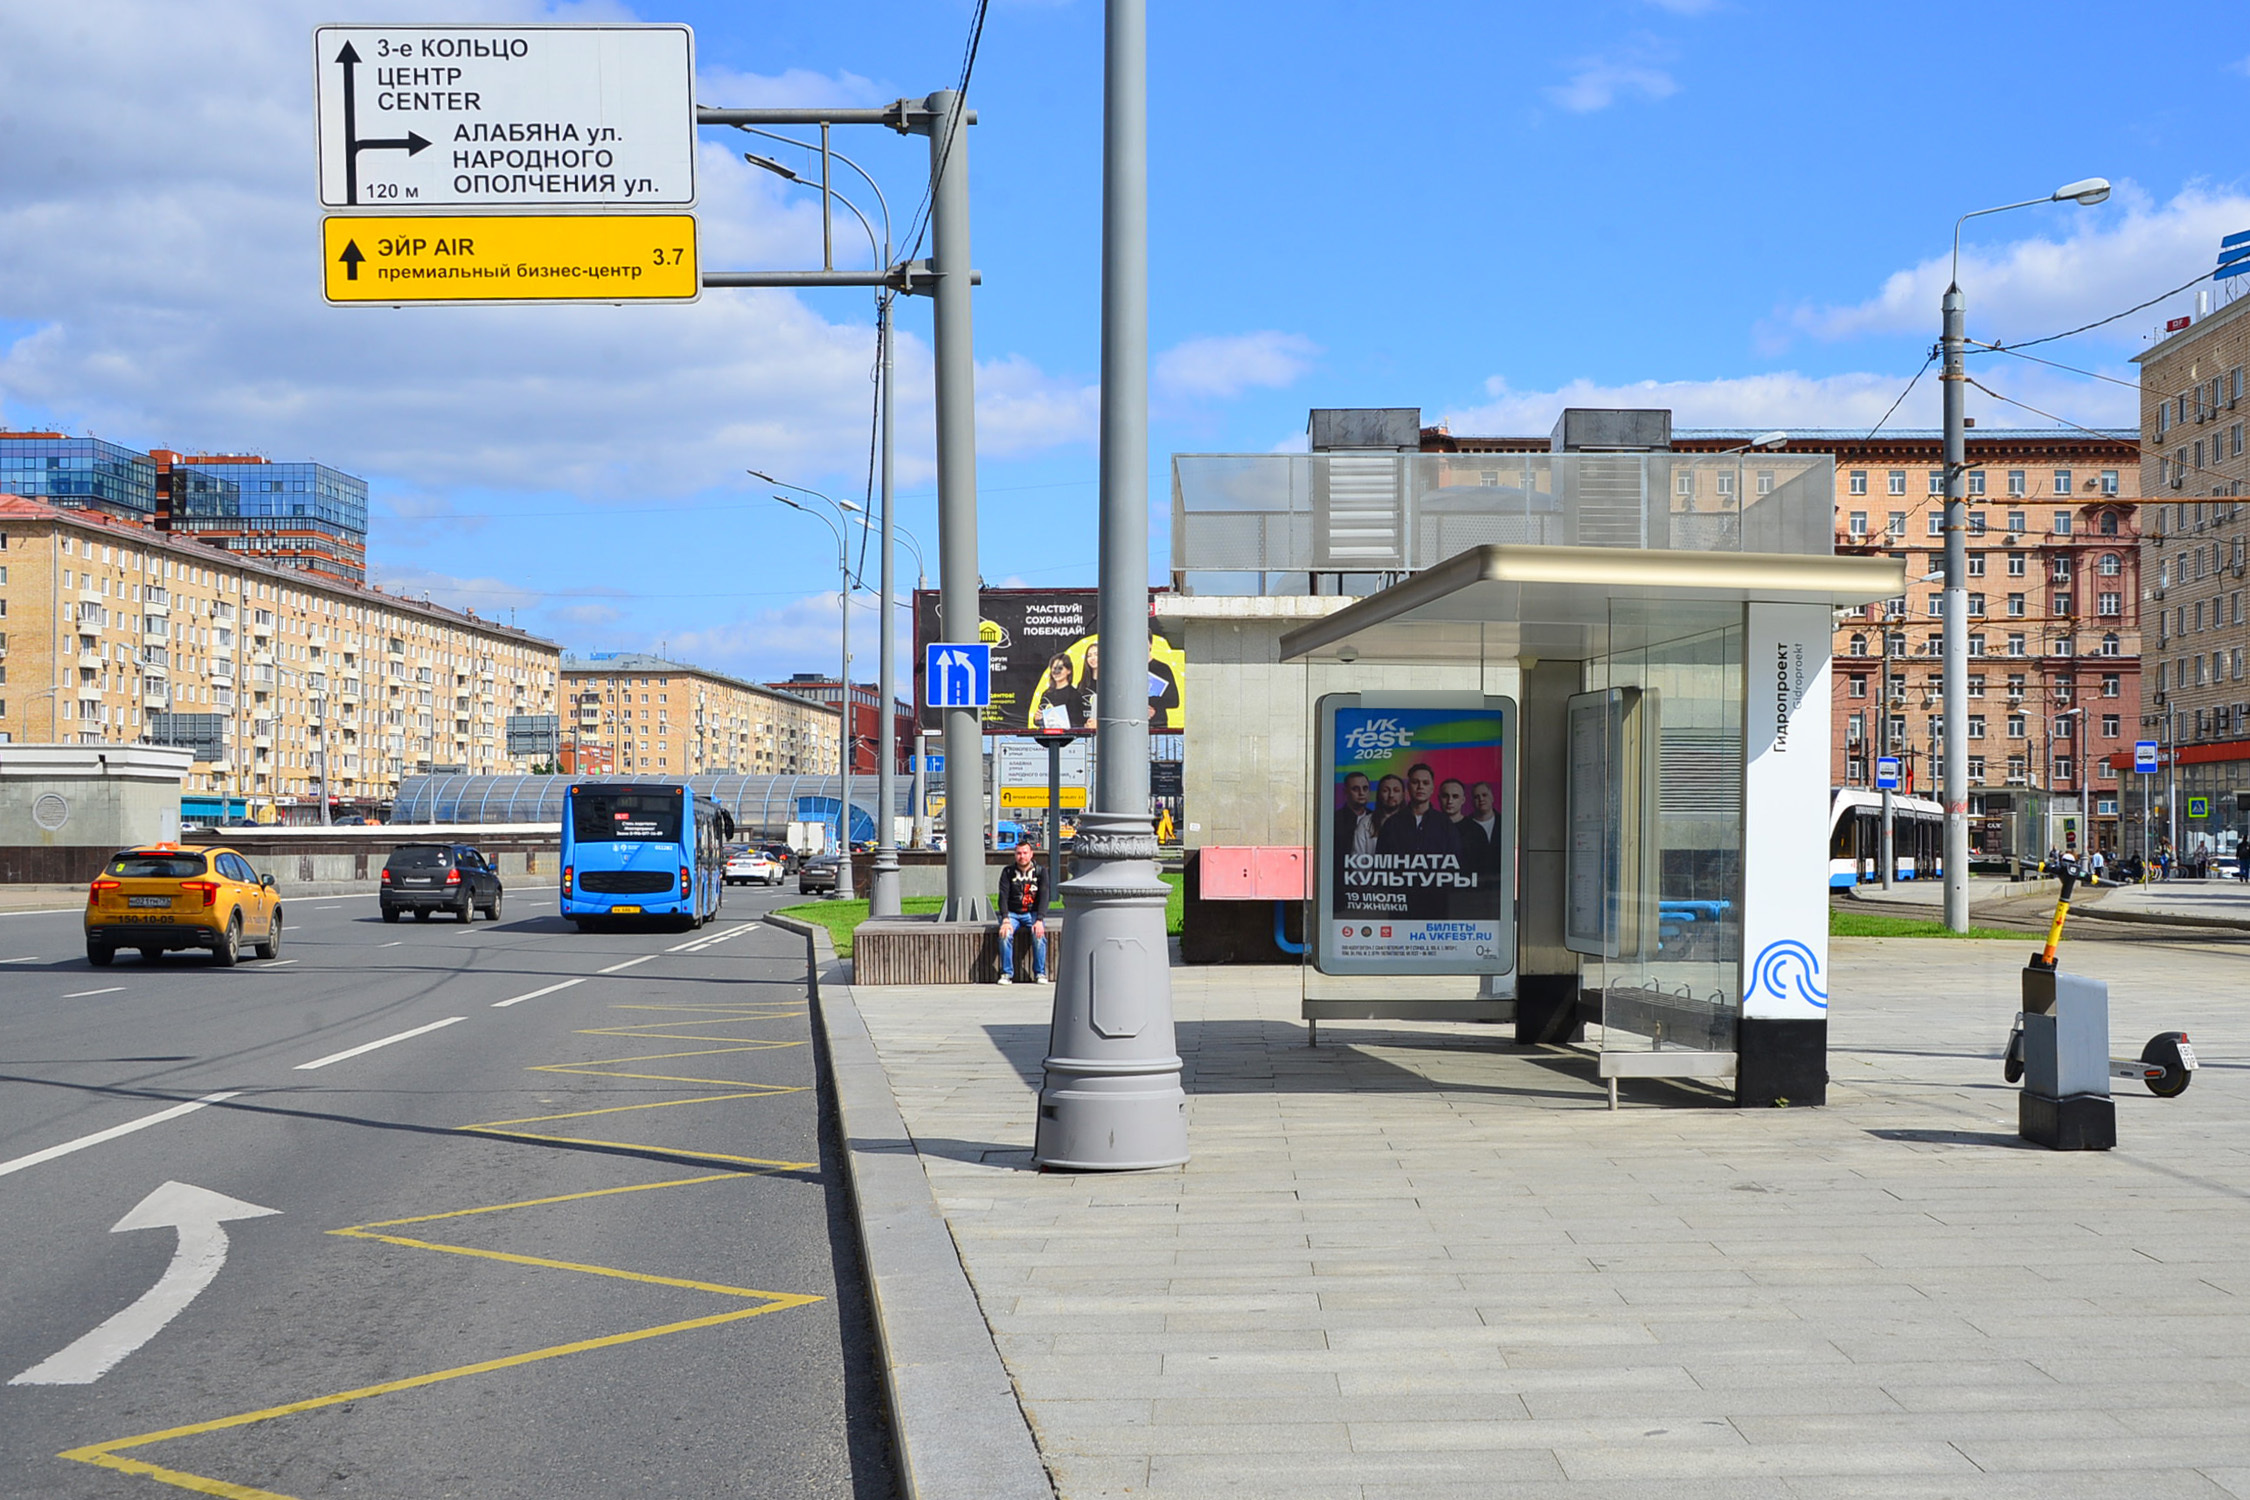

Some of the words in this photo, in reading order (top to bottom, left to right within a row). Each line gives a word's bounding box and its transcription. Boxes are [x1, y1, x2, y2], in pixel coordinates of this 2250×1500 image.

[377, 39, 413, 57] 3-е
[421, 38, 529, 61] КОЛЬЦО
[377, 67, 462, 89] ЦЕНТР
[377, 92, 482, 111] CENTER
[453, 123, 580, 142] АЛАБЯНА
[586, 127, 623, 146] ул.
[453, 149, 614, 172] НАРОДНОГО
[366, 184, 399, 199] 120
[405, 187, 419, 198] м
[453, 174, 616, 194] ОПОЛЧЕНИЯ
[623, 178, 660, 197] ул.
[377, 235, 427, 256] ЭЙР
[434, 238, 475, 256] AIR
[652, 248, 684, 266] 3.7
[377, 264, 511, 282] премиальный
[516, 262, 643, 282] бизнес-центр
[1026, 603, 1083, 614] УЧАСТВУЙ!
[1025, 614, 1083, 625] СОХРАНЯЙ!
[1023, 626, 1086, 636] ПОБЕЖДАЙ!
[1793, 643, 1805, 710] Gidroproekt
[1773, 642, 1790, 753] Гидропроект
[1366, 718, 1398, 732] VK
[1345, 728, 1414, 748] fest
[1354, 749, 1393, 760] 2025
[1344, 854, 1460, 870] КОМНАТА
[1344, 871, 1478, 888] КУЛЬТУРЫ
[1345, 892, 1360, 902] 19
[1362, 892, 1407, 903] ИЮЛЯ
[1347, 902, 1408, 912] ЛУЖНИКИ
[118, 915, 175, 924] 150-10-05
[1425, 923, 1476, 932] БИЛЕТЫ
[1409, 932, 1427, 941] НА
[1429, 931, 1492, 941] VKFEST.RU
[1475, 945, 1492, 957] 0+
